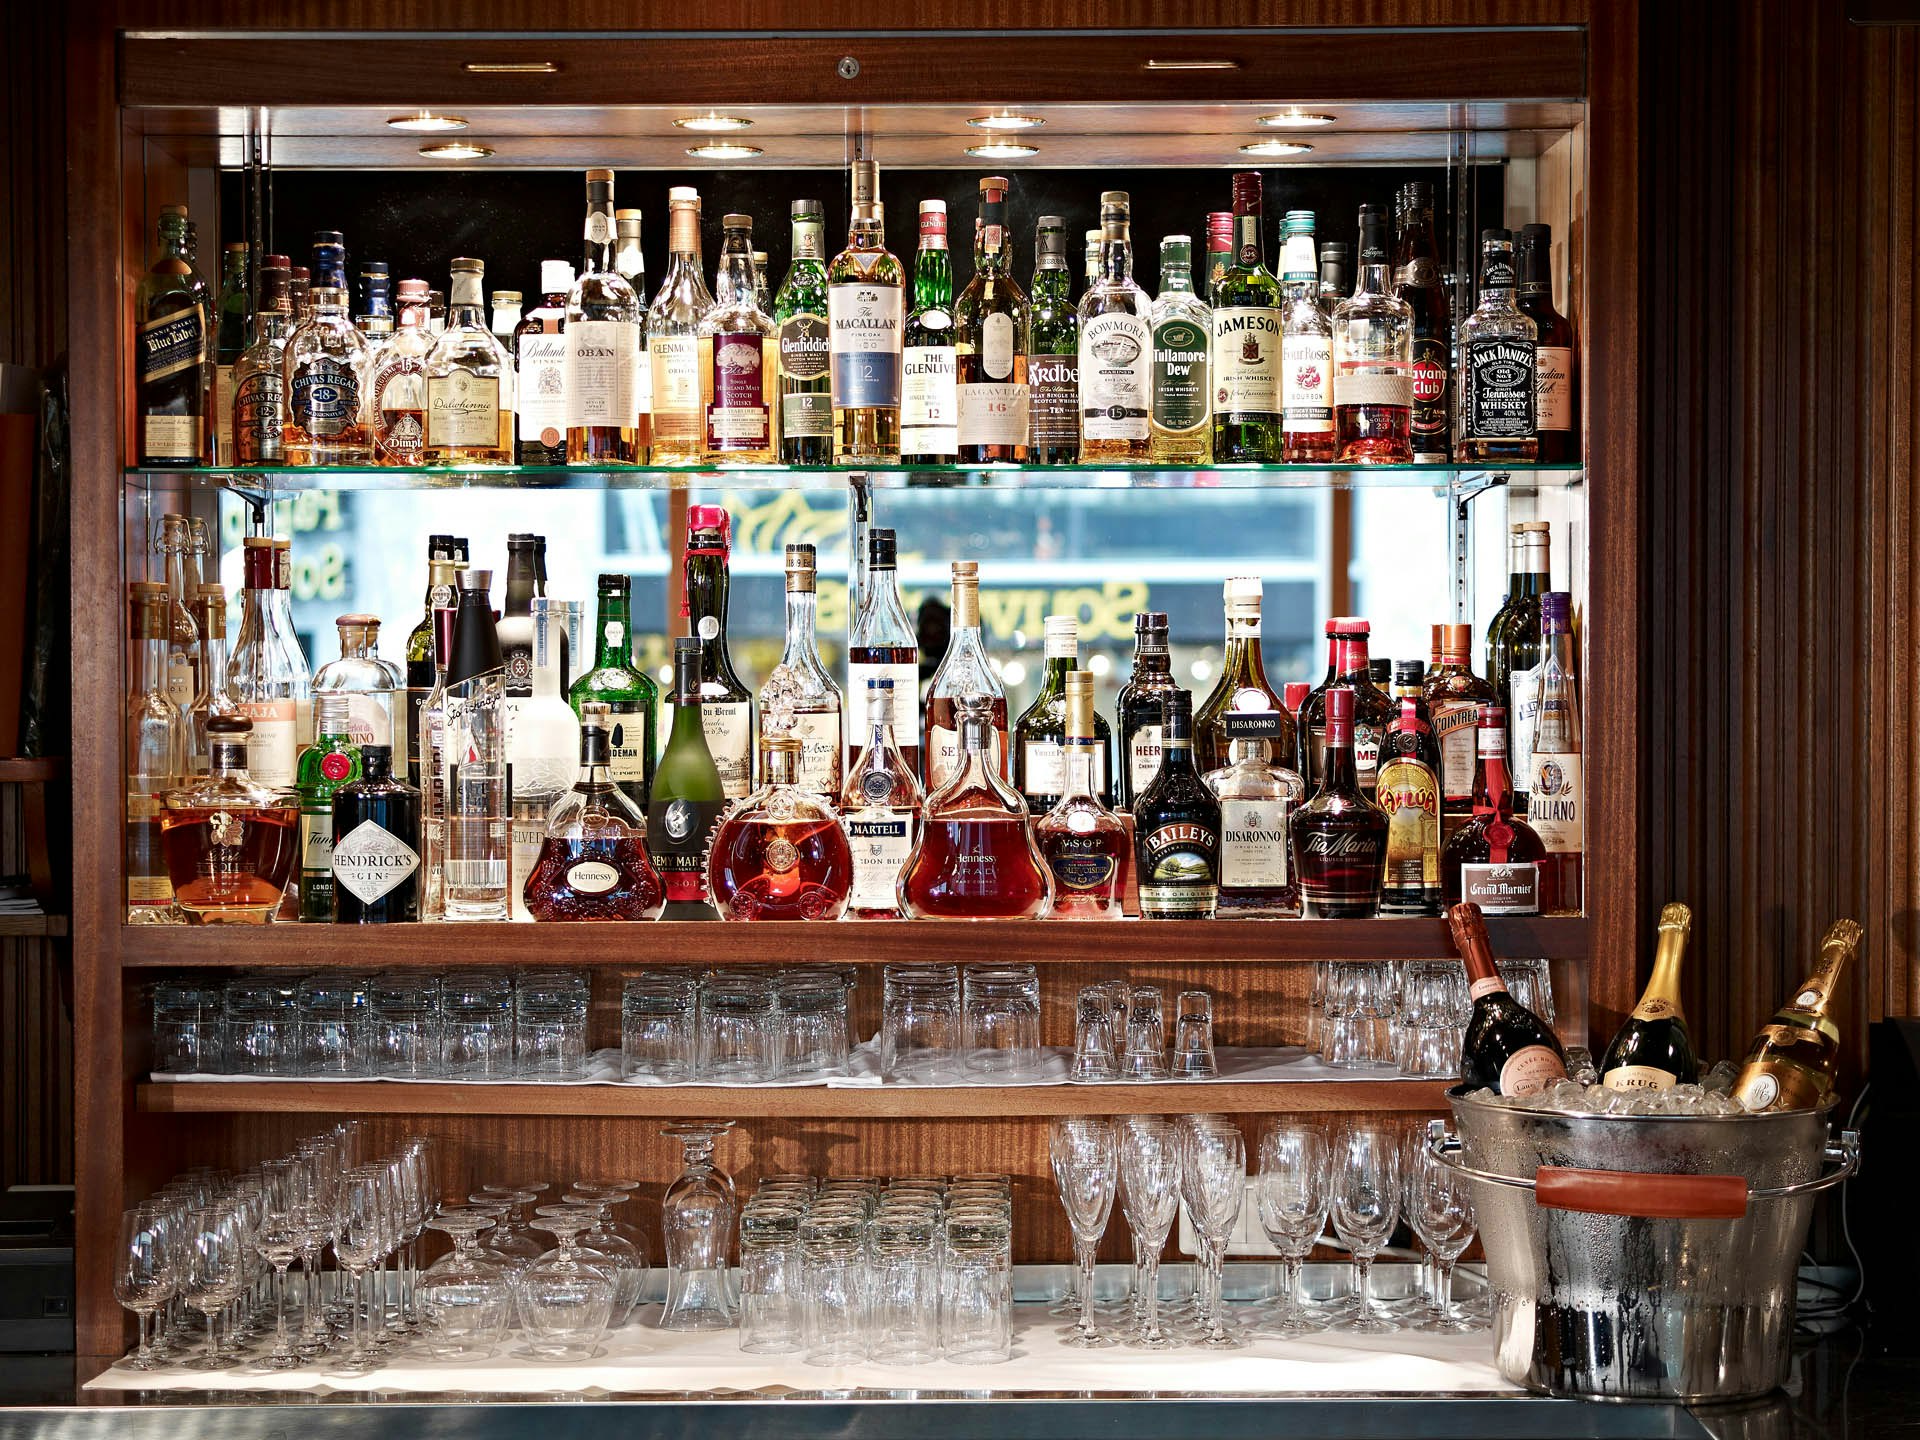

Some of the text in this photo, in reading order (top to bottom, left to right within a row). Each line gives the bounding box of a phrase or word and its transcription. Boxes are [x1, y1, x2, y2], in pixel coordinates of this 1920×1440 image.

[836, 319, 897, 329] MACALLAN
[1217, 316, 1281, 337] JAMESON
[1088, 321, 1145, 341] BOWMORE
[782, 337, 831, 353] Glenfiddich
[577, 348, 615, 357] OBAN
[924, 354, 943, 363] THE
[1153, 349, 1205, 362] Tullamore
[1303, 347, 1331, 360] Roses
[1473, 346, 1534, 368] JACK DANIEL'S
[859, 365, 873, 378] 12
[905, 364, 956, 375] GLENLIVE
[1029, 361, 1080, 386] Ardbe
[1167, 363, 1190, 377] Dew
[1412, 367, 1447, 380] avana
[294, 375, 357, 390] CHIVAS REGAL
[1412, 381, 1440, 394] Club
[318, 389, 330, 400] 18
[1482, 387, 1526, 399] Tennessee
[802, 397, 813, 407] 12
[989, 402, 1007, 412] 16
[1480, 402, 1528, 410] WHISKEY
[929, 408, 940, 418] 12
[1111, 408, 1123, 418] 15
[1231, 720, 1276, 730] DISARONNO
[1435, 709, 1479, 734] COINTREA
[1136, 746, 1161, 756] HEER
[1377, 783, 1437, 816] KAHLÚA
[854, 825, 900, 834] MARTELL
[1149, 827, 1214, 849] BAILEYS
[1225, 831, 1281, 843] DISARONNO
[1304, 832, 1376, 857] Tia Maria
[334, 854, 412, 867] HENDRICK'S
[574, 872, 612, 882] Hennessy
[1470, 882, 1532, 895] Grand Marnier
[1616, 1079, 1658, 1090] KRUG
